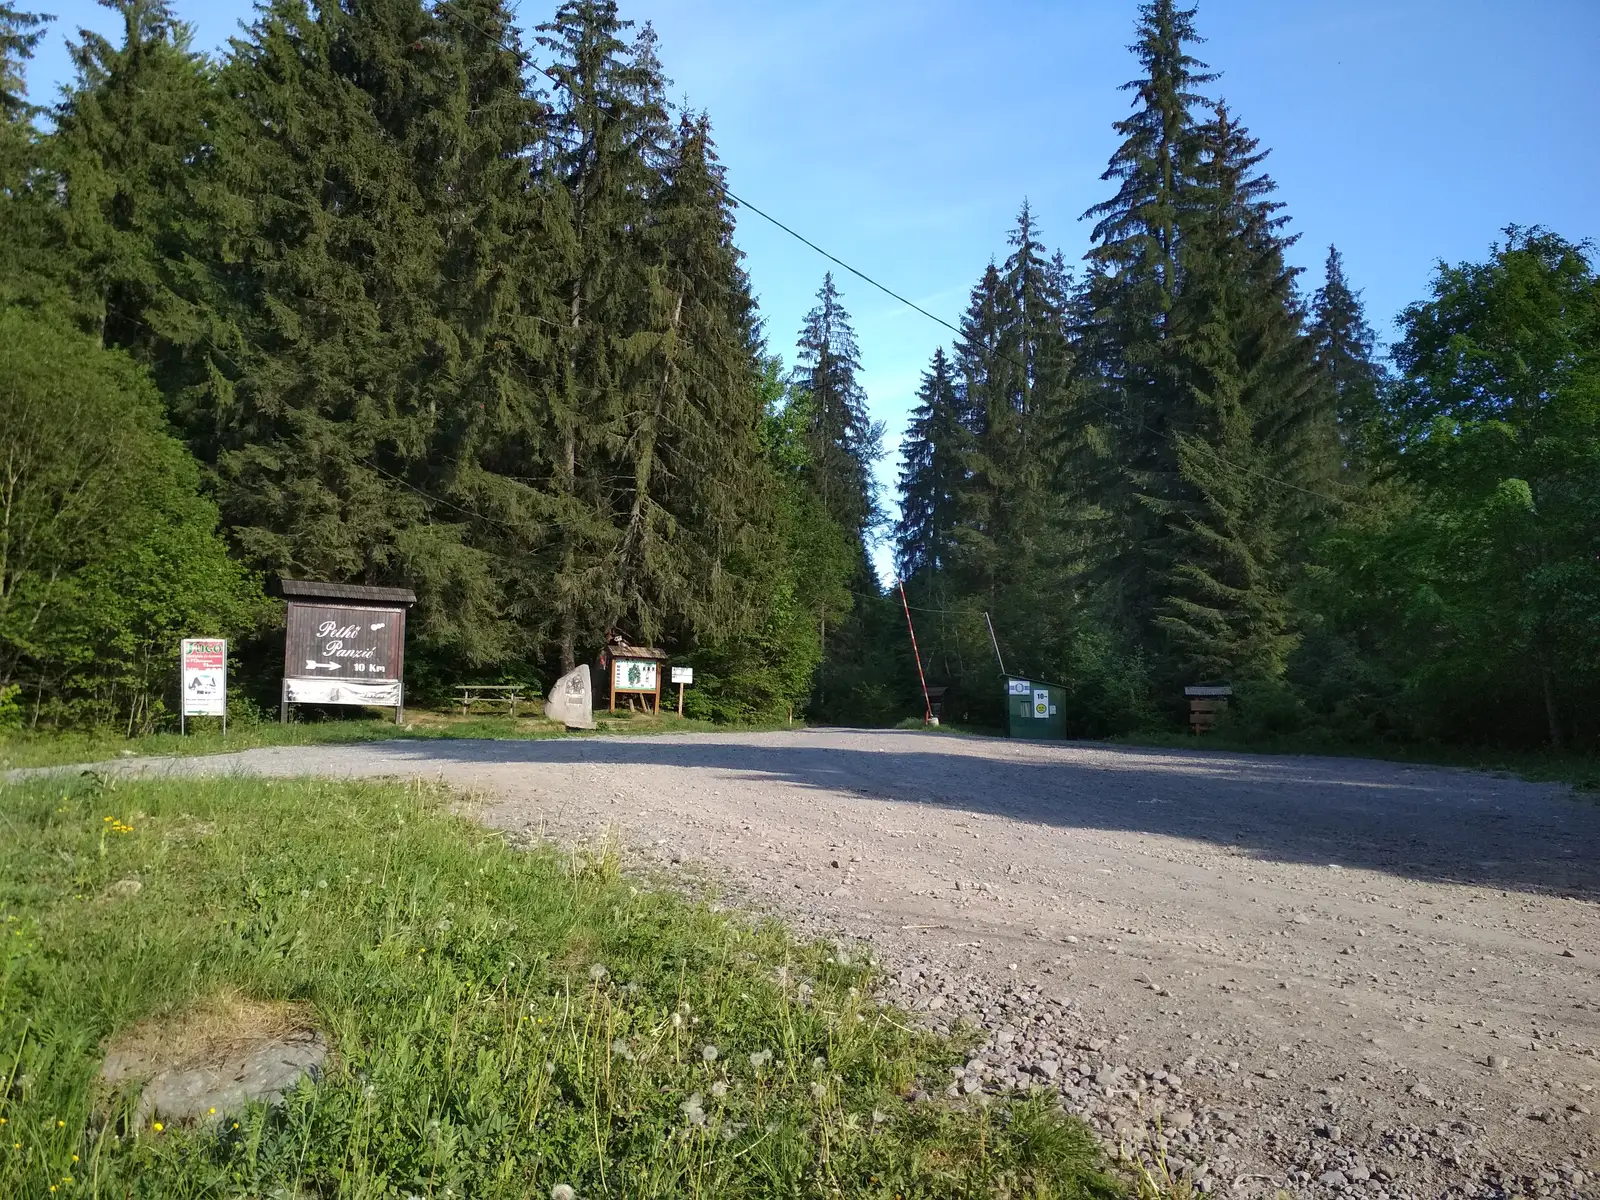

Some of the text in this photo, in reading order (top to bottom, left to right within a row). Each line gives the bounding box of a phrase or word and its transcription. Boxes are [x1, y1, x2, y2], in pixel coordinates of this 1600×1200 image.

[316, 621, 361, 638] Pethő
[323, 640, 376, 658] Panzió
[354, 663, 386, 673] 10 Km
